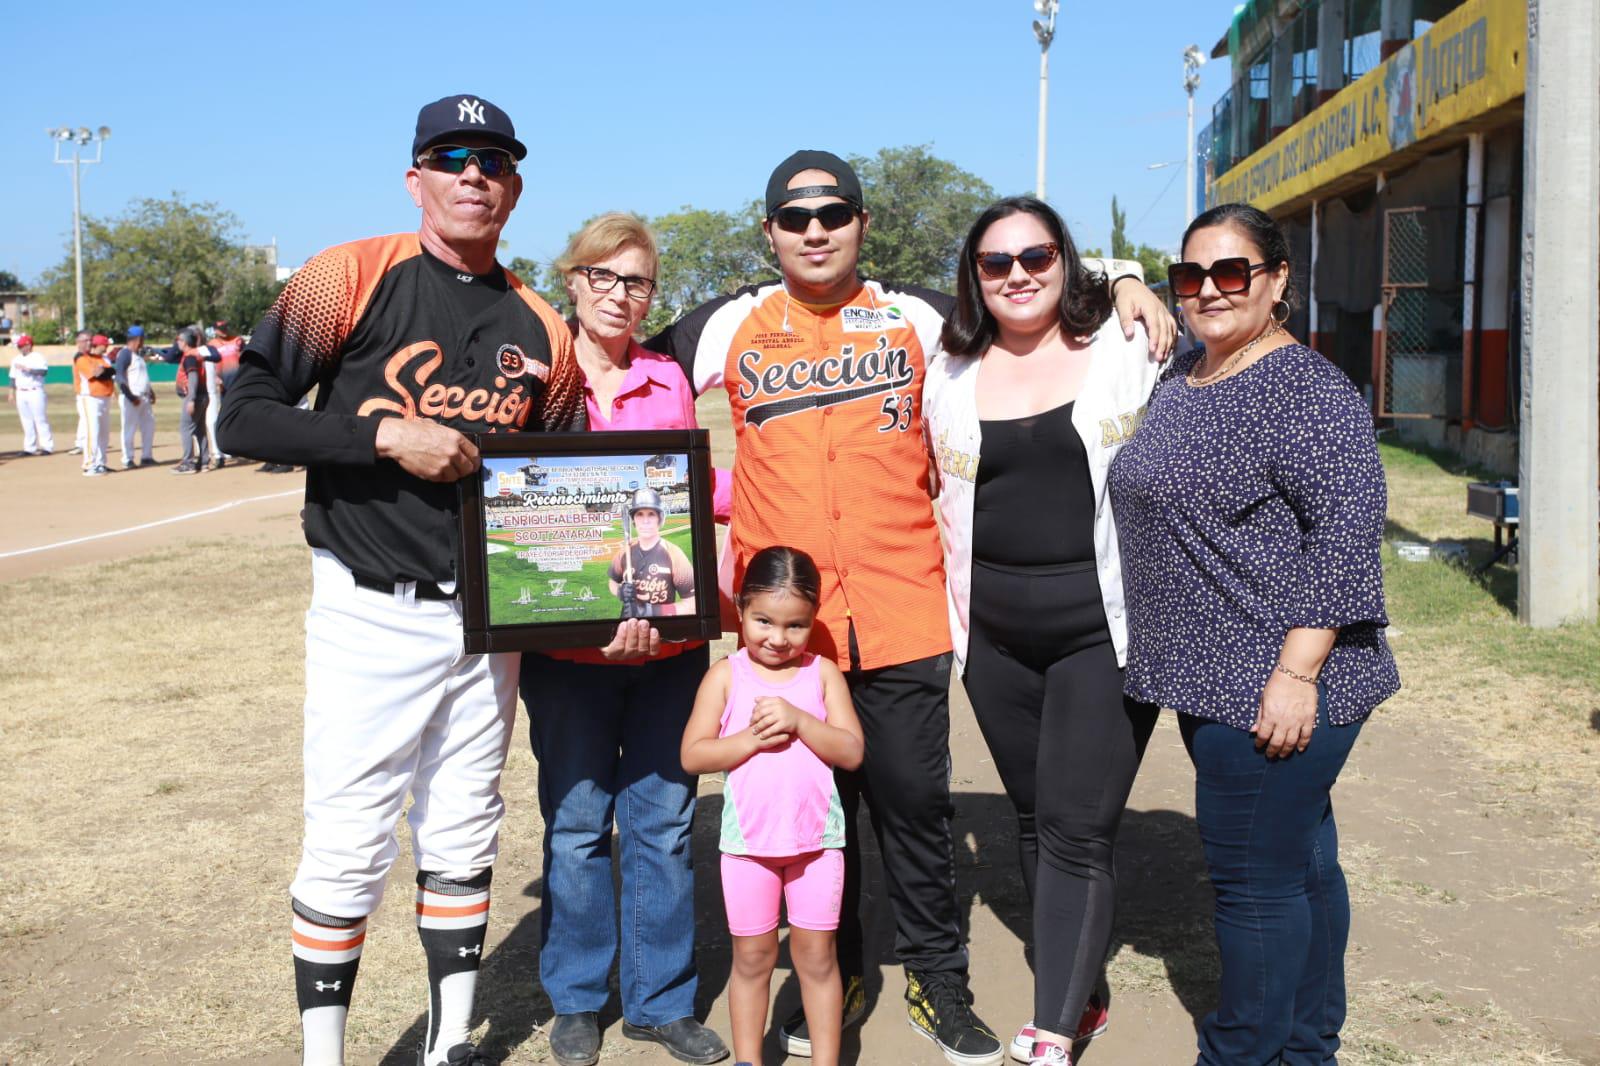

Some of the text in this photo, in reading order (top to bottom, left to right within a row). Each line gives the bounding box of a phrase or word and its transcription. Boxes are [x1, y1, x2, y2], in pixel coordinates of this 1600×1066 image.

[458, 99, 485, 124] NY
[737, 336, 914, 399] Sección
[878, 395, 913, 432] 53
[499, 473, 521, 485] SNTE
[647, 468, 672, 478] SNTE
[523, 491, 627, 509] Reconocimiento
[504, 512, 611, 526] ENRIQUE ALBERTO
[516, 528, 602, 541] SCOTT ZATARAIN
[650, 590, 668, 603] 53
